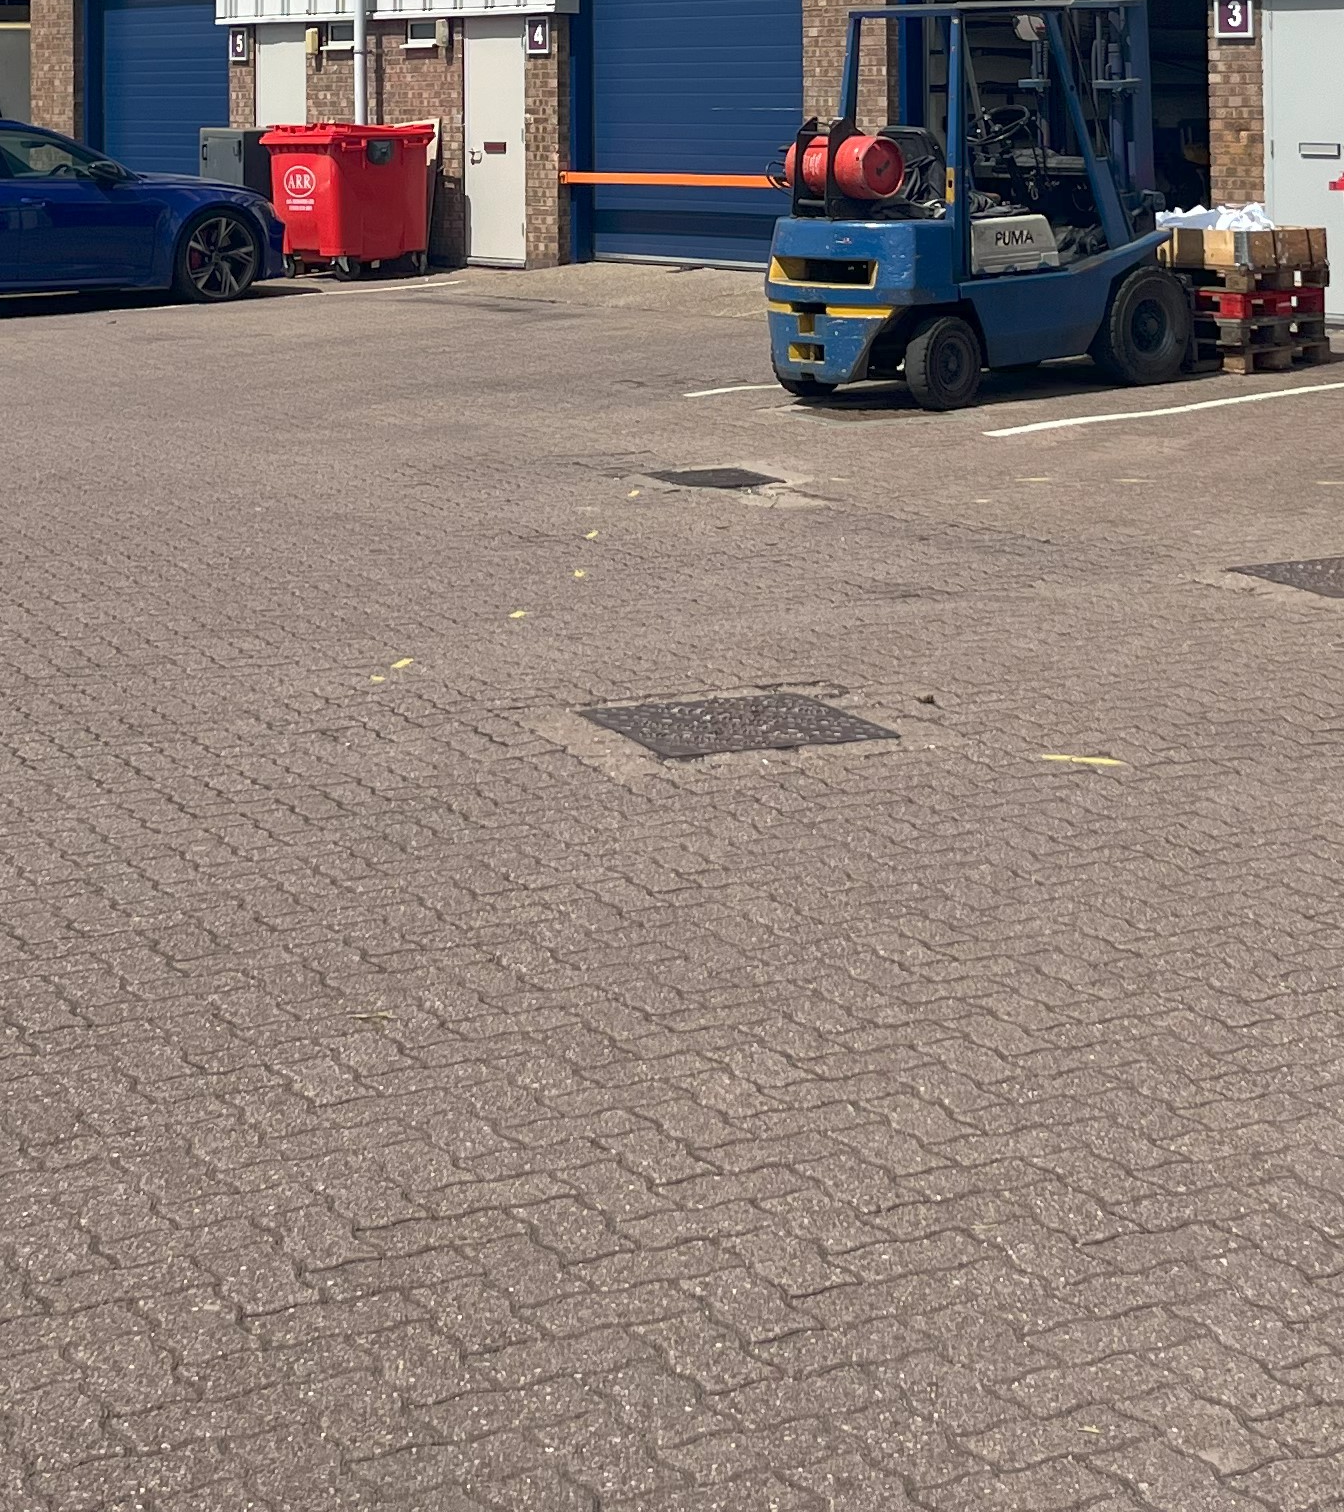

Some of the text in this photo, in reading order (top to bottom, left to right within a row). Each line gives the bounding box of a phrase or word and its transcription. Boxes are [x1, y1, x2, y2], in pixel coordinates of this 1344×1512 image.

[1227, 0, 1242, 27] 3
[236, 34, 243, 53] 5
[533, 24, 544, 45] 4
[288, 174, 312, 189] ARR
[995, 230, 1035, 246] PUMA
